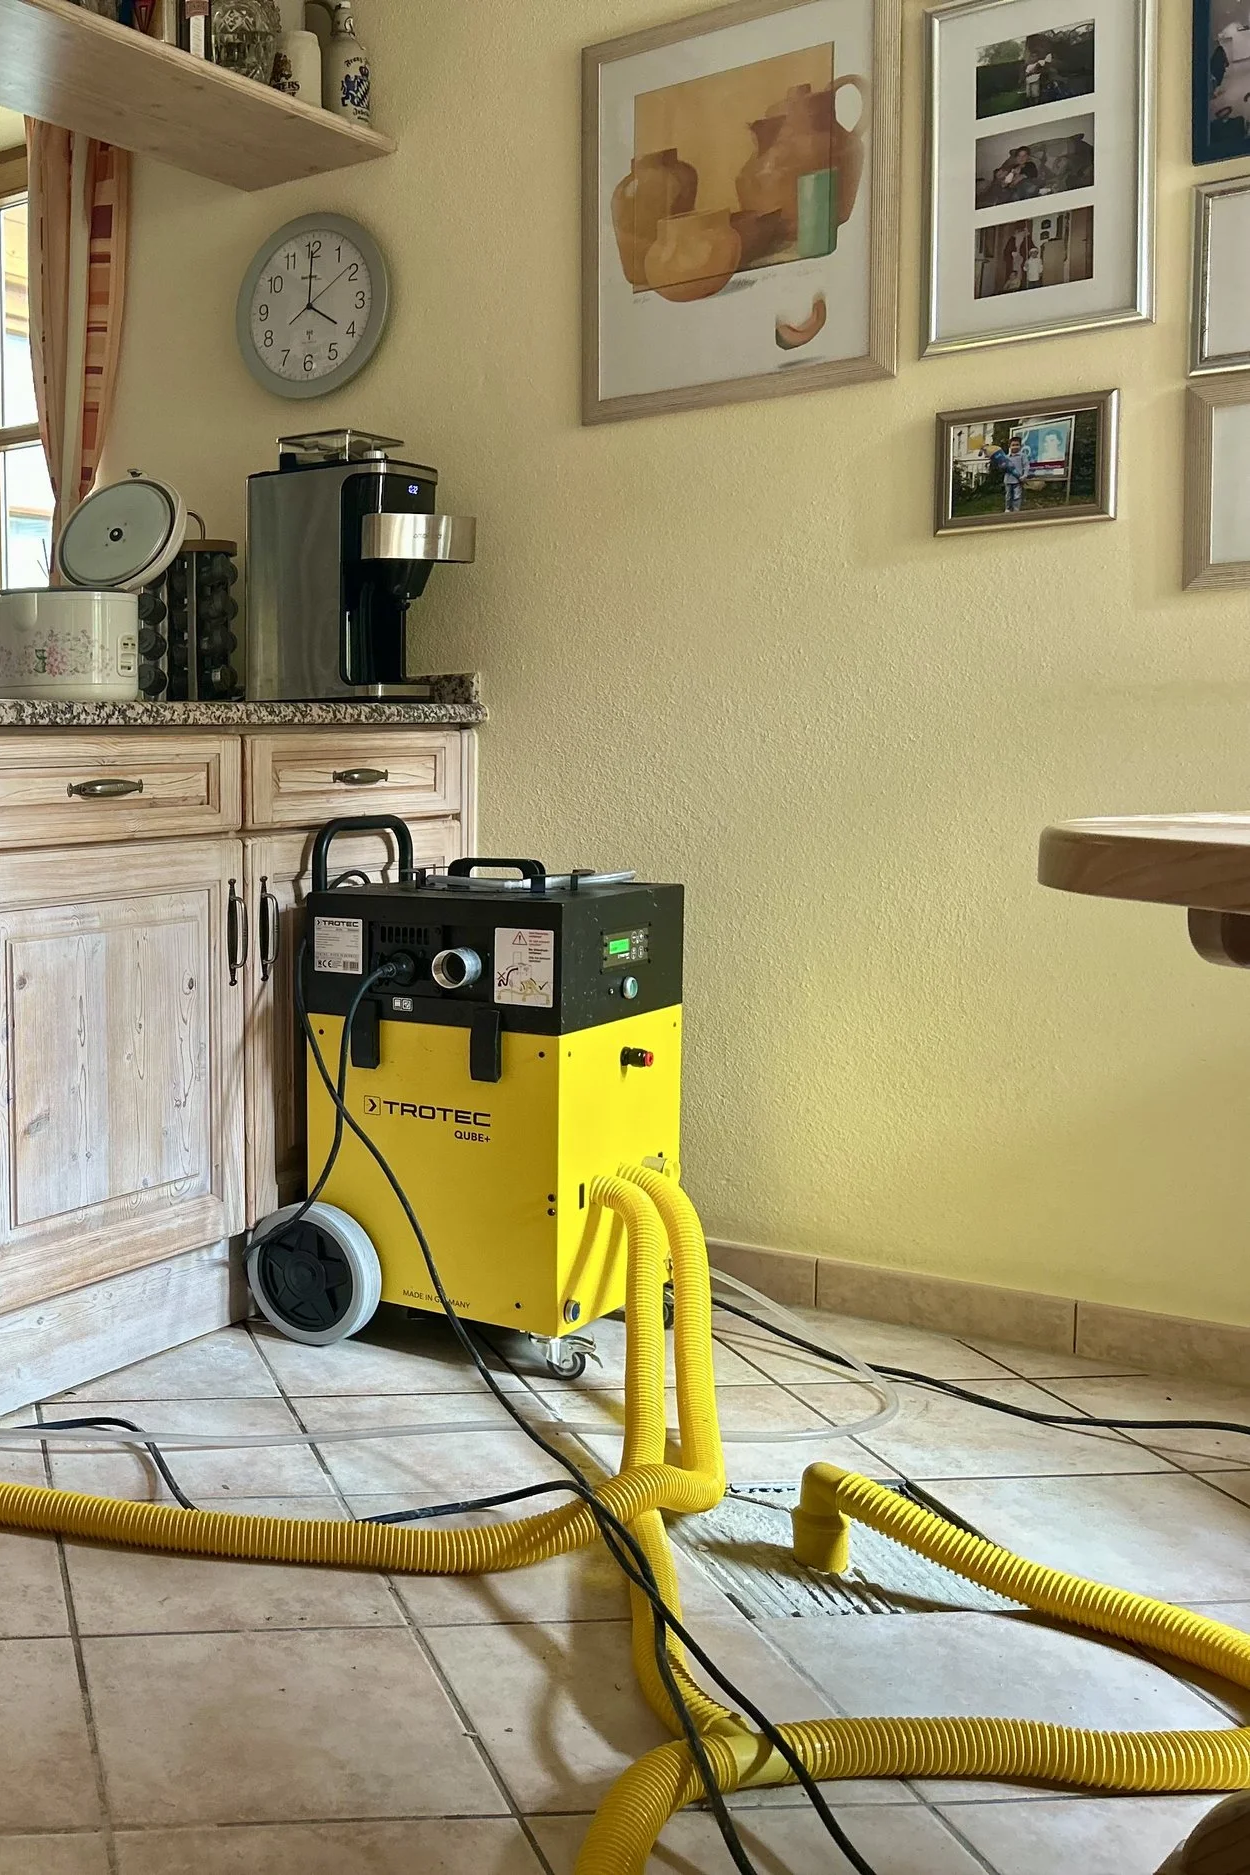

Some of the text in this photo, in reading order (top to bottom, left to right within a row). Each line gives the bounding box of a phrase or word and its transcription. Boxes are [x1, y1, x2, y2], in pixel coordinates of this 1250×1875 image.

[304, 240, 322, 259] 12
[335, 246, 341, 263] 1
[284, 252, 296, 270] 11
[348, 263, 359, 282] 2
[267, 275, 283, 294] 10
[354, 291, 365, 309] 3
[258, 304, 269, 322] 9
[263, 329, 274, 347] 8
[346, 321, 356, 338] 4
[281, 349, 291, 367] 7
[327, 343, 338, 361] 5
[303, 354, 314, 371] 6
[322, 920, 359, 928] TROTEC
[383, 1100, 491, 1127] TROTEC
[454, 1130, 491, 1143] QUBE+
[402, 1289, 471, 1309] MADE IN GMANY
